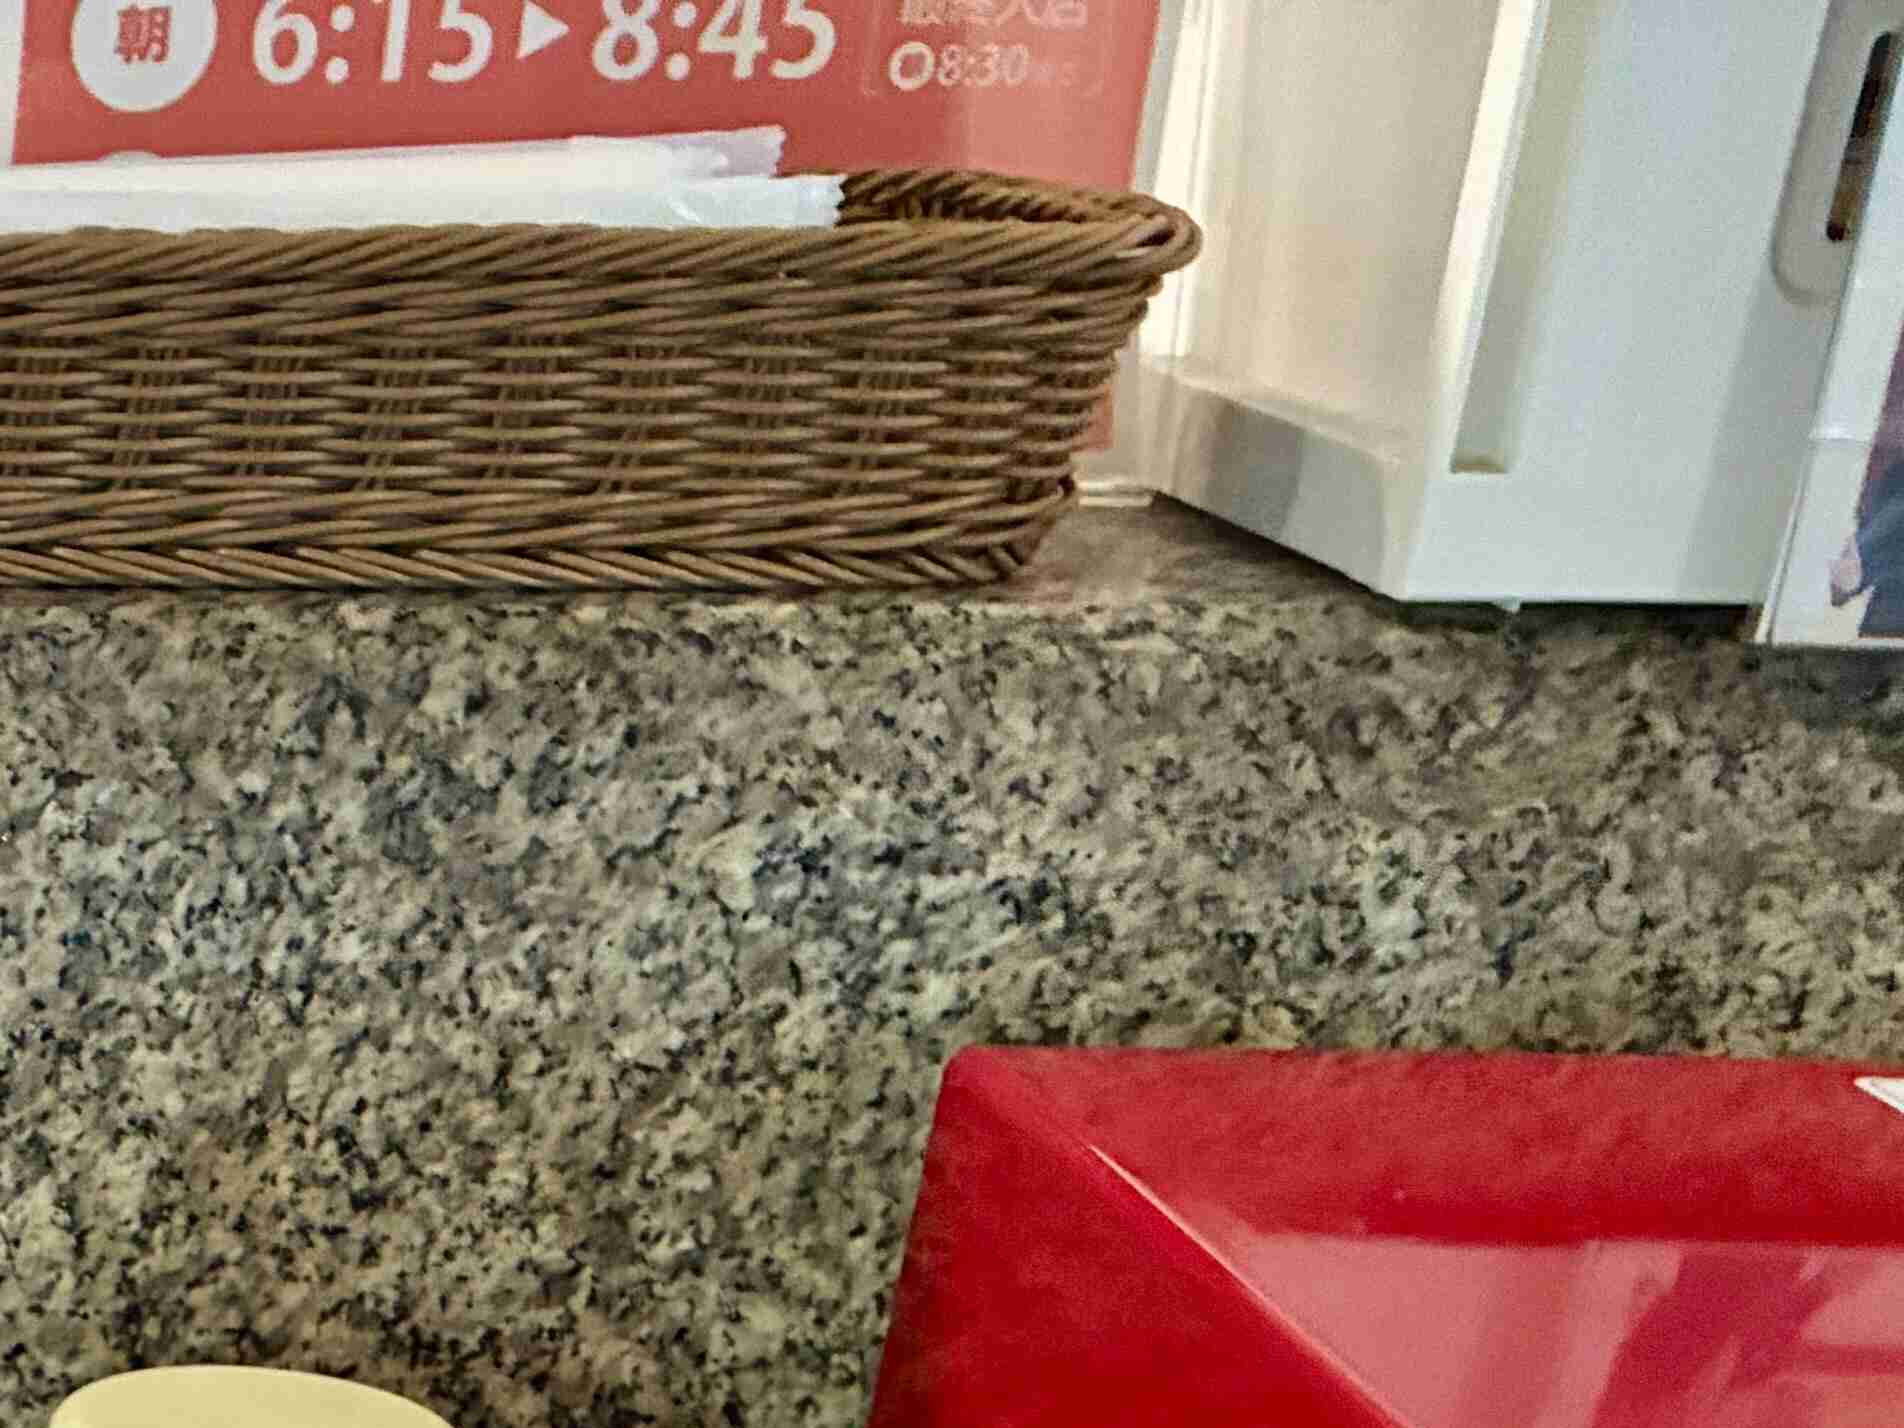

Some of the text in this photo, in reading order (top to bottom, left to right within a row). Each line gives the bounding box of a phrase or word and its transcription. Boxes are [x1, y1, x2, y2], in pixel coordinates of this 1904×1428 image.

[116, 3, 173, 64] 朝
[253, 0, 837, 85] 6:15 8:45
